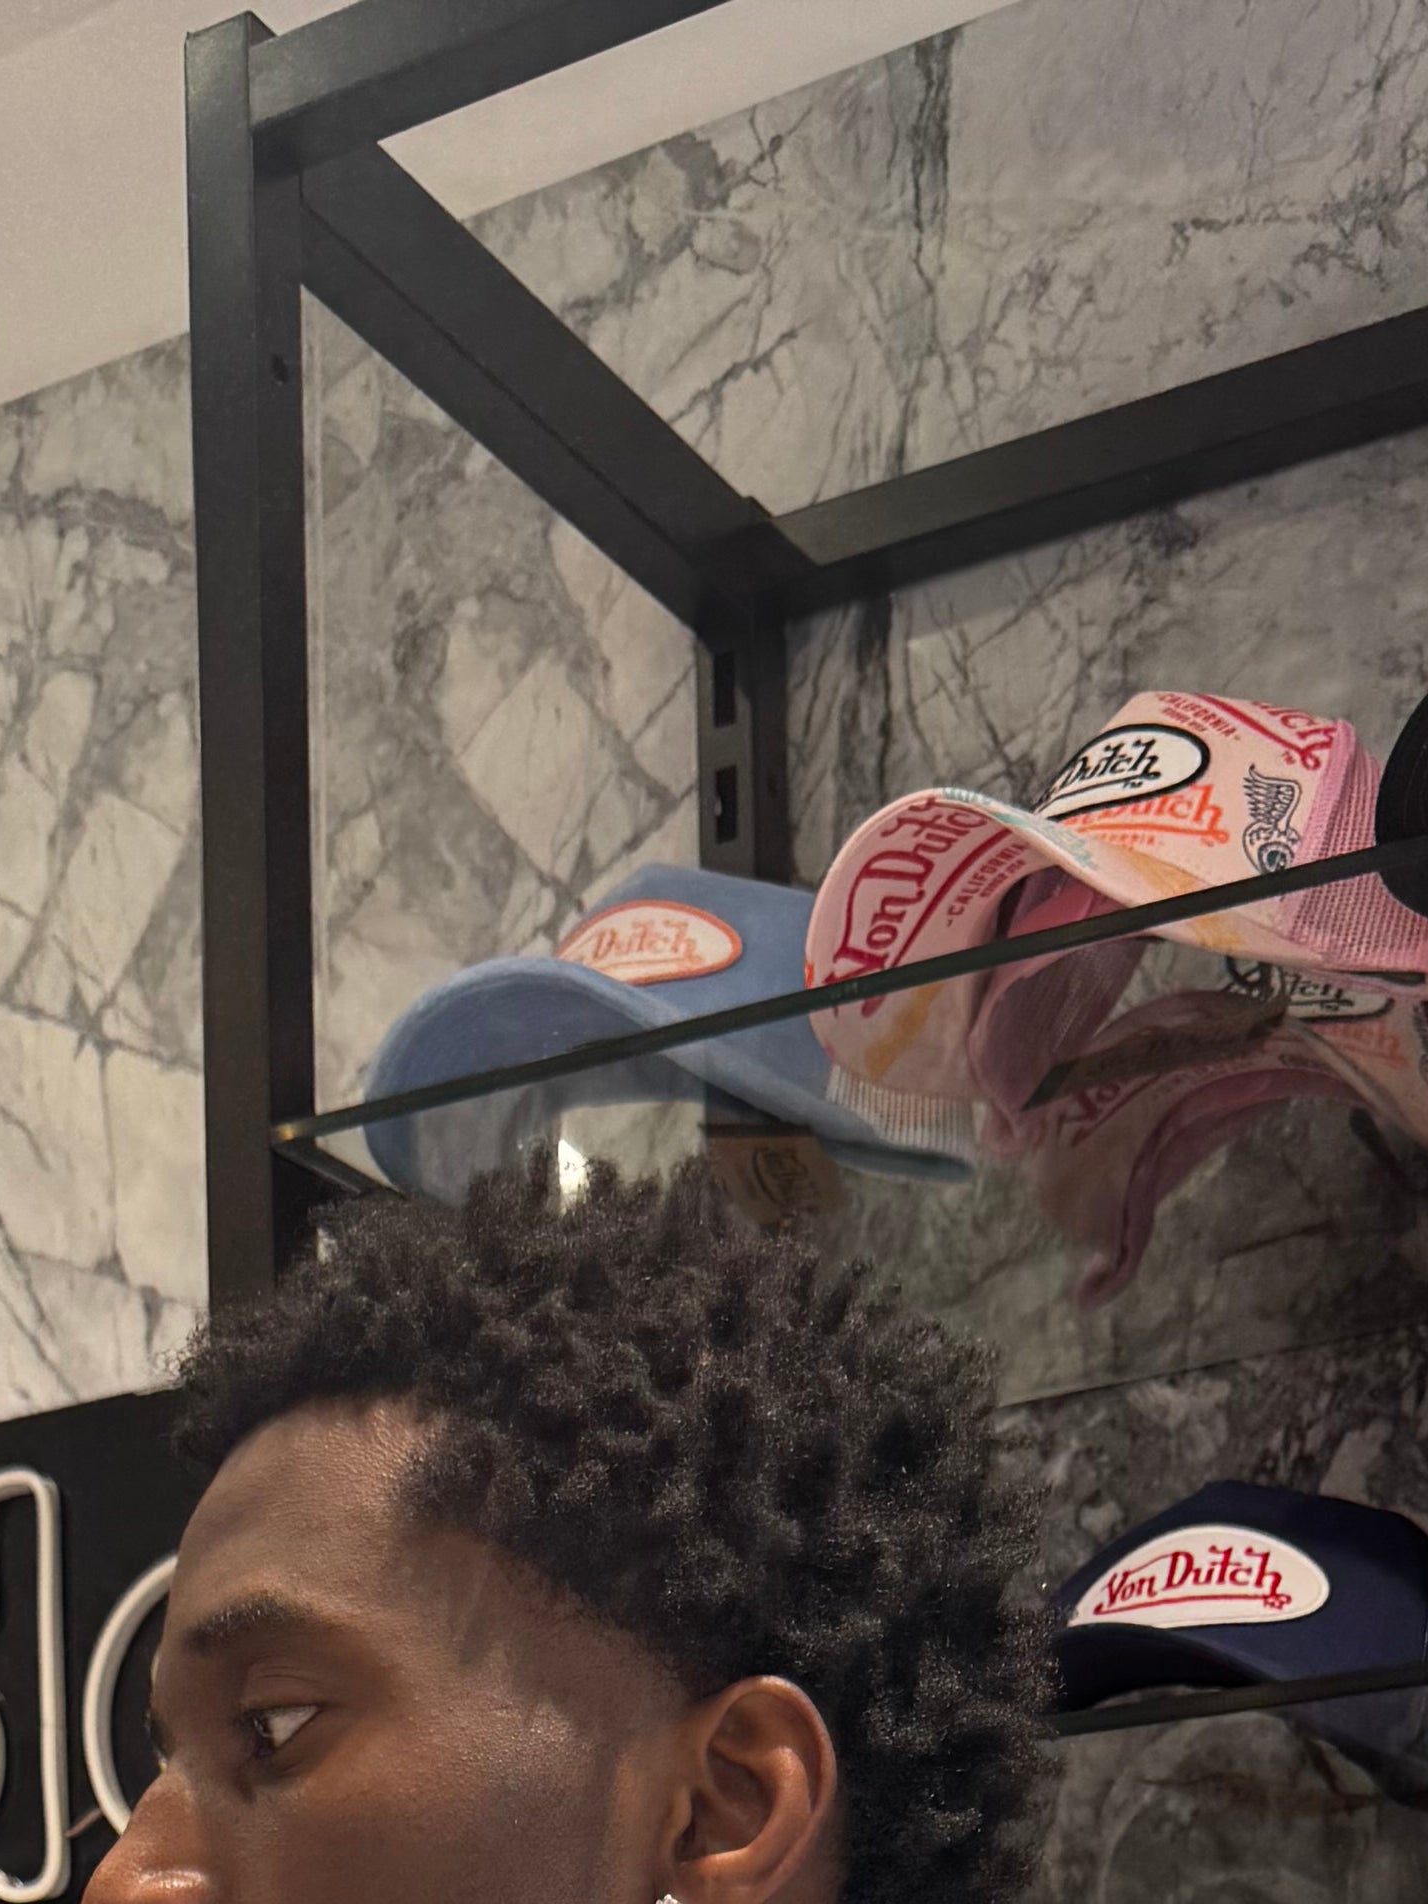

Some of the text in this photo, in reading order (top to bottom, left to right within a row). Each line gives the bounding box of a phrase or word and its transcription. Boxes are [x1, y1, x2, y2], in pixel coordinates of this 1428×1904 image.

[1059, 738, 1161, 789] Dutch
[1102, 1545, 1284, 1607] Von Dutch
